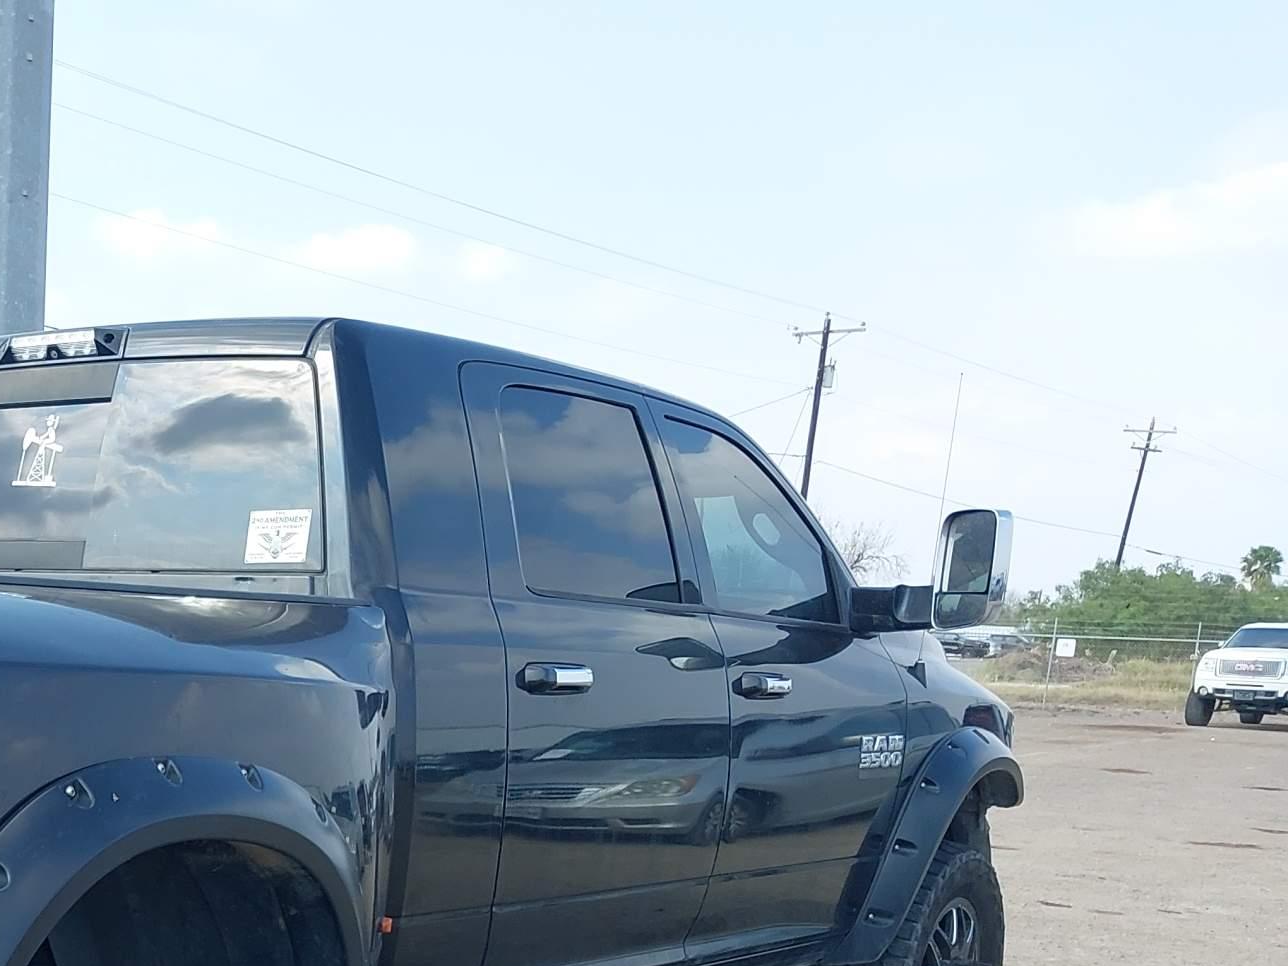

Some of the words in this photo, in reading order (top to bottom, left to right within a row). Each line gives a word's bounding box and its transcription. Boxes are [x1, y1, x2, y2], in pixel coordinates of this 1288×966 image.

[264, 515, 309, 523] AMENDMENT
[861, 735, 904, 752] RAM
[859, 751, 903, 769] 3500
